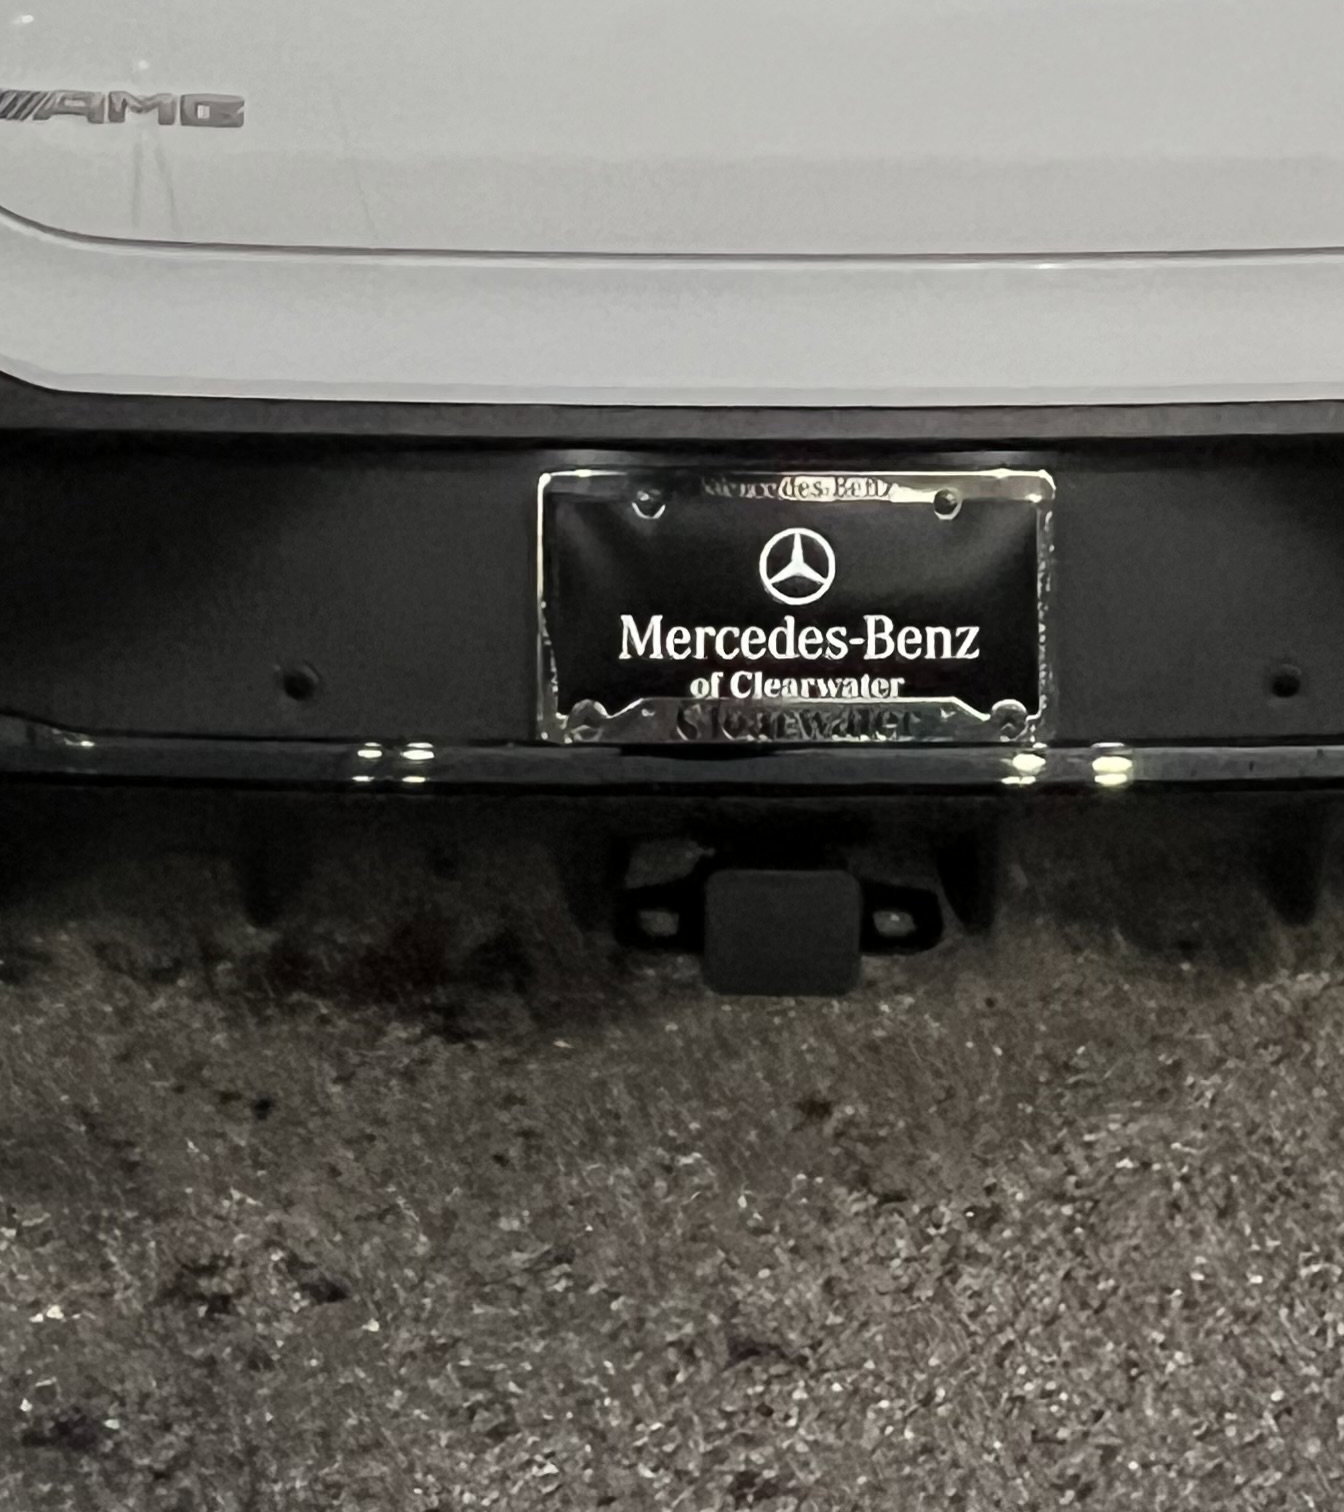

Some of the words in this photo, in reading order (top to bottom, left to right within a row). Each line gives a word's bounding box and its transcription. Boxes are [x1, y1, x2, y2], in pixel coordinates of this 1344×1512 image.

[618, 614, 981, 661] Mercedes-Benz
[689, 671, 724, 699] of
[729, 670, 905, 700] Clearwater
